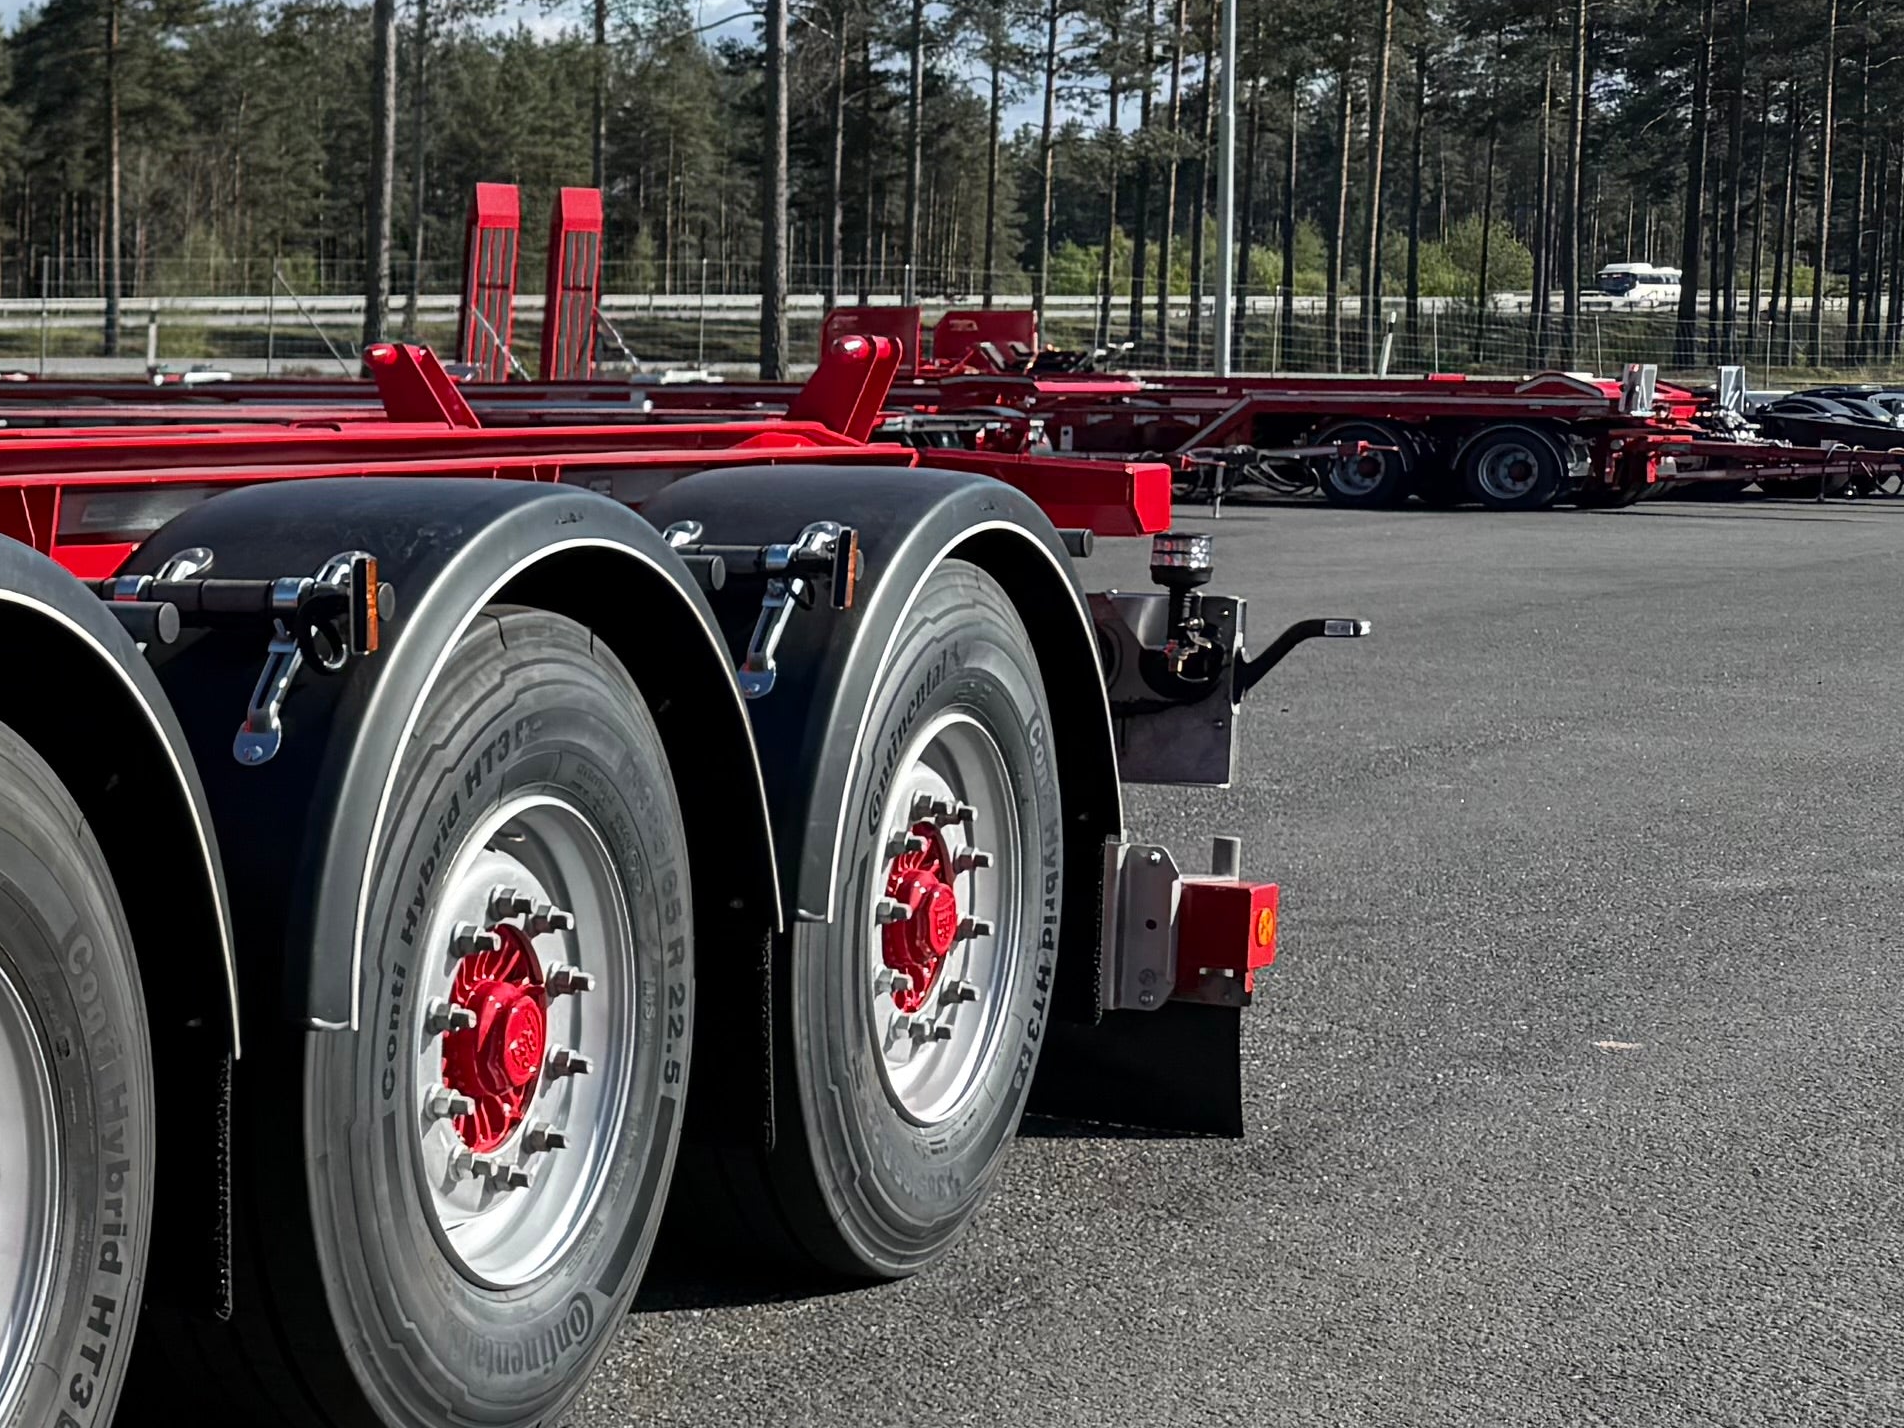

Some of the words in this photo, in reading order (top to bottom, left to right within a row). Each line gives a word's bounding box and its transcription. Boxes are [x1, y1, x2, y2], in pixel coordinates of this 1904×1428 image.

[869, 649, 947, 836] Continental
[381, 963, 407, 1101] Conti
[400, 790, 461, 947] Hybrid
[463, 728, 511, 799] HT3
[667, 938, 685, 972] R
[662, 982, 686, 1086] 22.5
[98, 1079, 132, 1278] Hybrid
[69, 1294, 117, 1411] HT3
